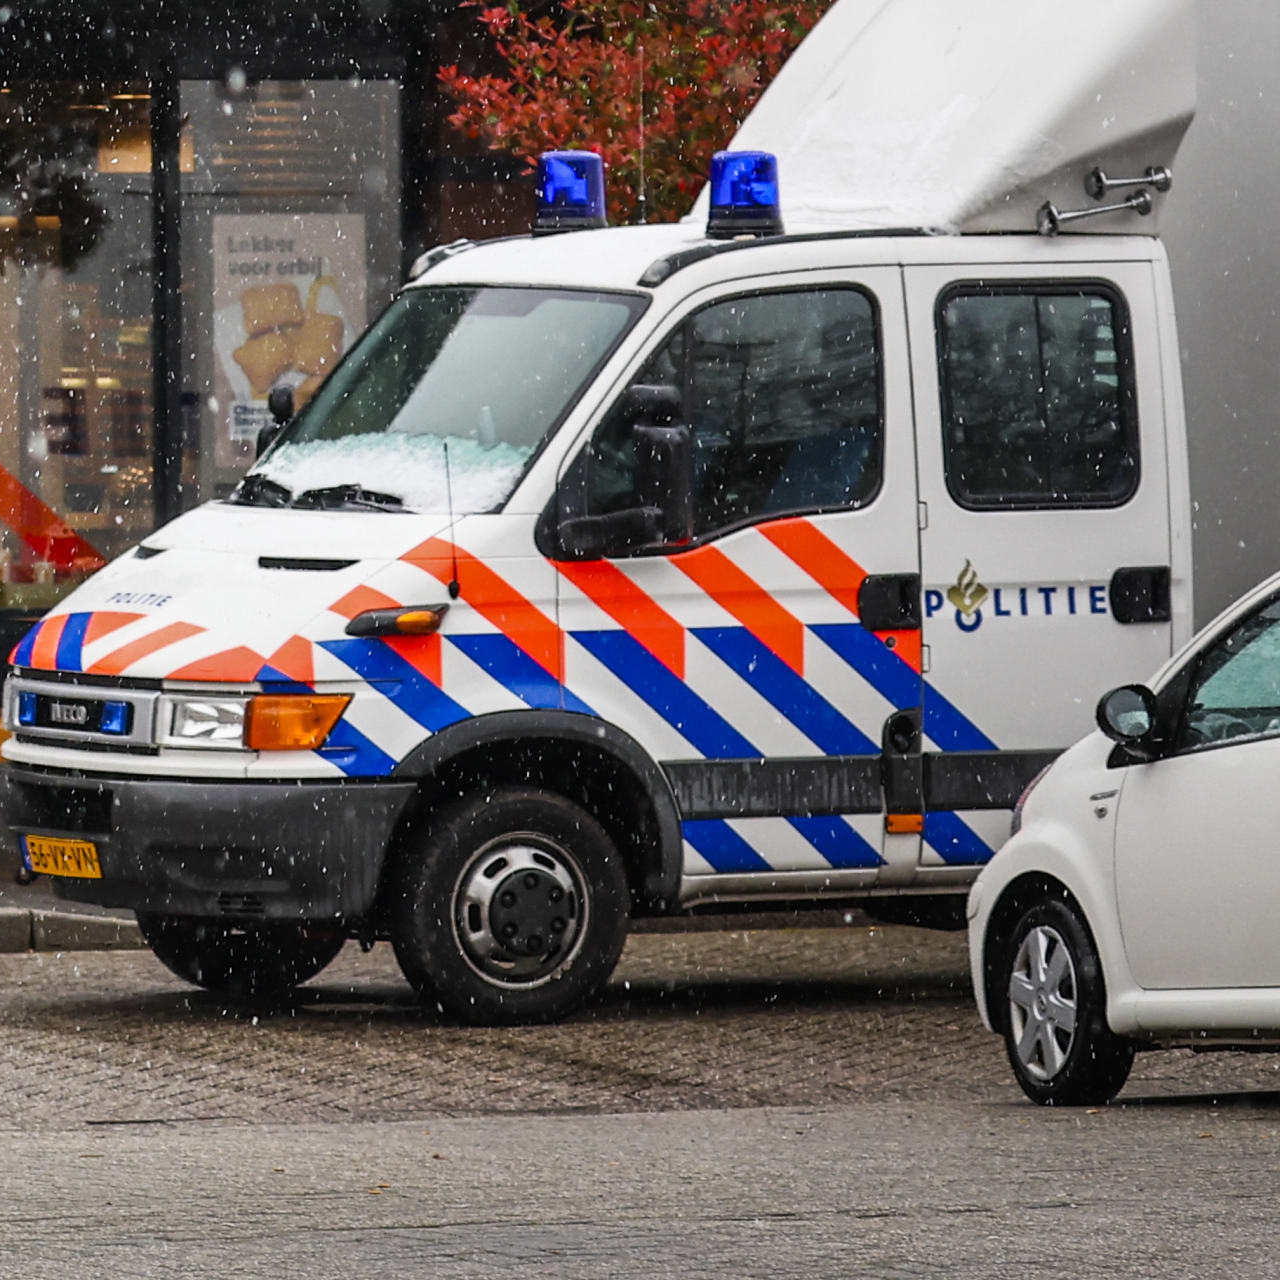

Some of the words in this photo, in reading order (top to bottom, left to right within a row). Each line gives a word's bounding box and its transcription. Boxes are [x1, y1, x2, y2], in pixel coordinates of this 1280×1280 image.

[227, 235, 296, 253] Lekker
[228, 261, 271, 276] voor
[105, 592, 173, 607] POLITIE
[925, 586, 1107, 632] POLITIE
[51, 703, 88, 724] IVECO
